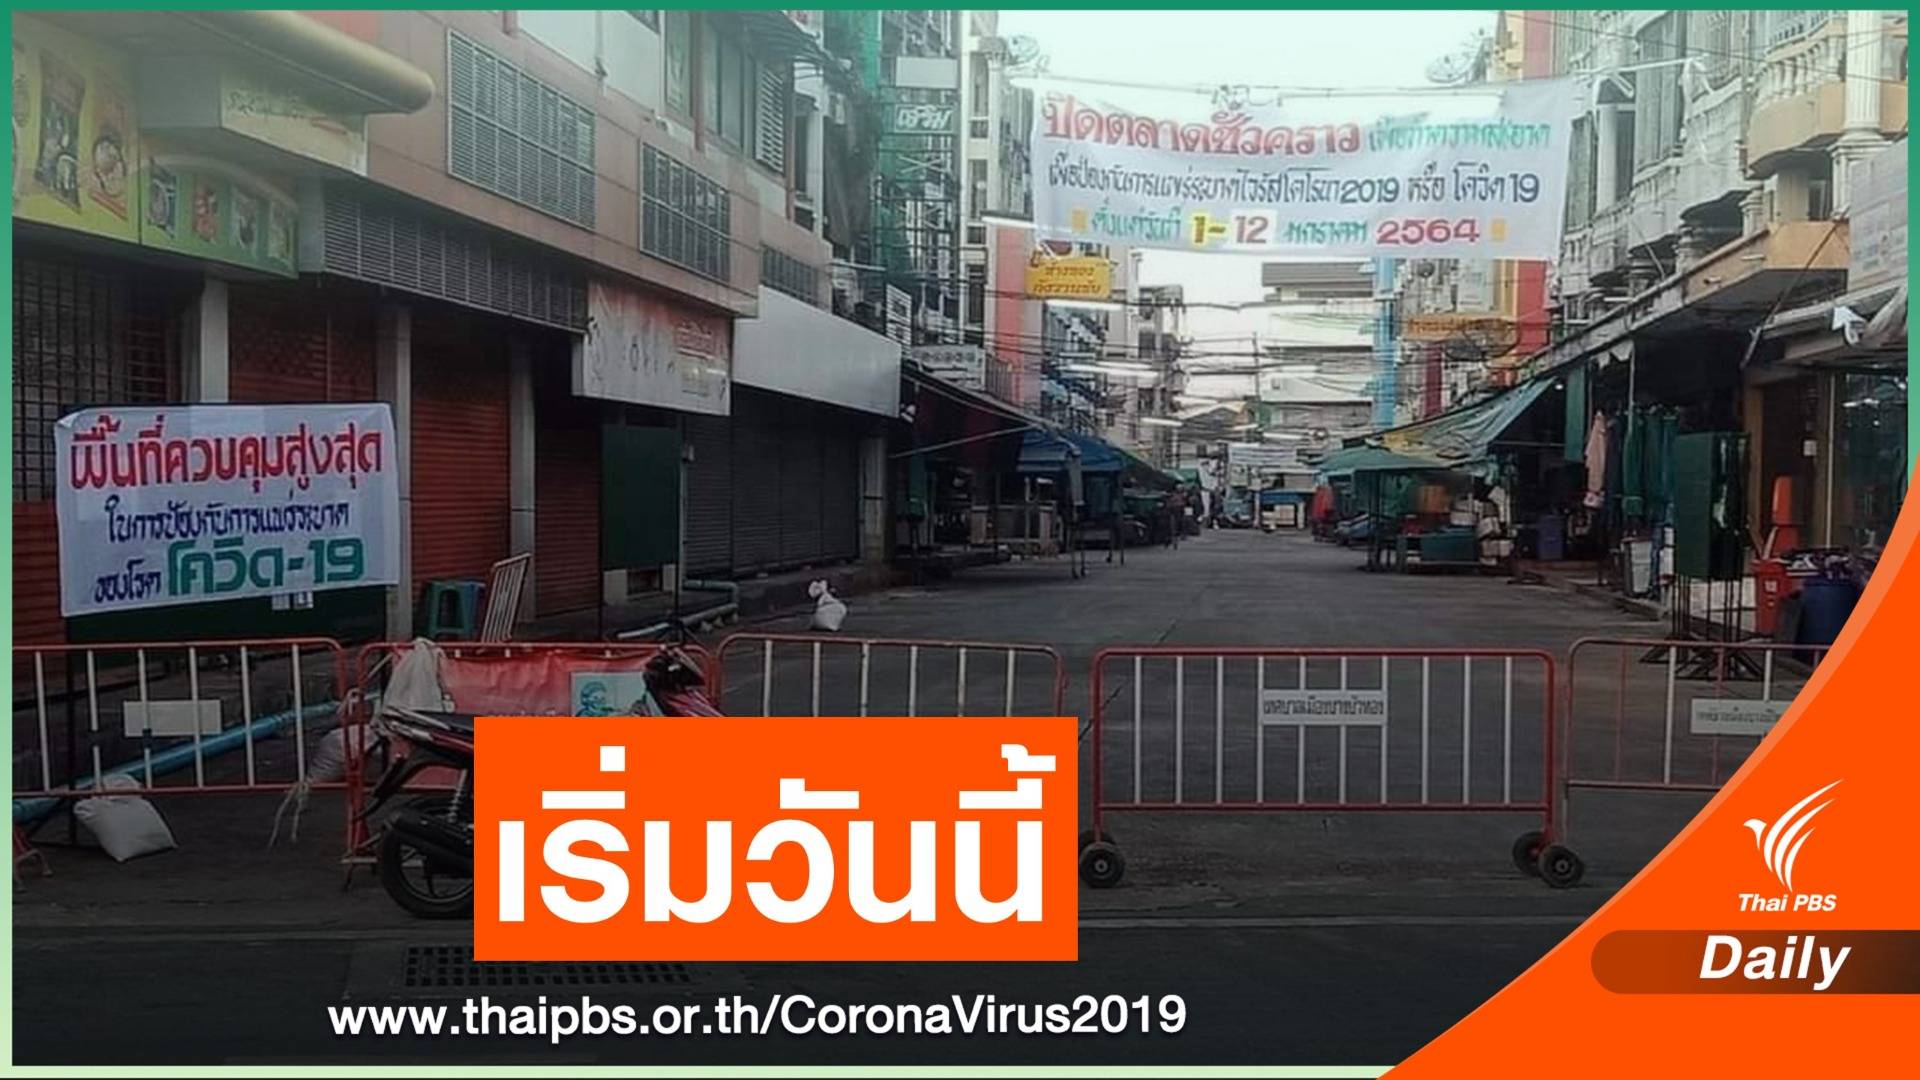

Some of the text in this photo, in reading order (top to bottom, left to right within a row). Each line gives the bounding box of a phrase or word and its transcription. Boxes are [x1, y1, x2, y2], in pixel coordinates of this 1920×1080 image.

[1041, 89, 1360, 156] ปิดตลาดชั่วคราว
[1377, 216, 1480, 244] 2564
[70, 415, 381, 493] พื้นที่ควบคุมสูงสุด
[167, 536, 365, 597] โควิด-19
